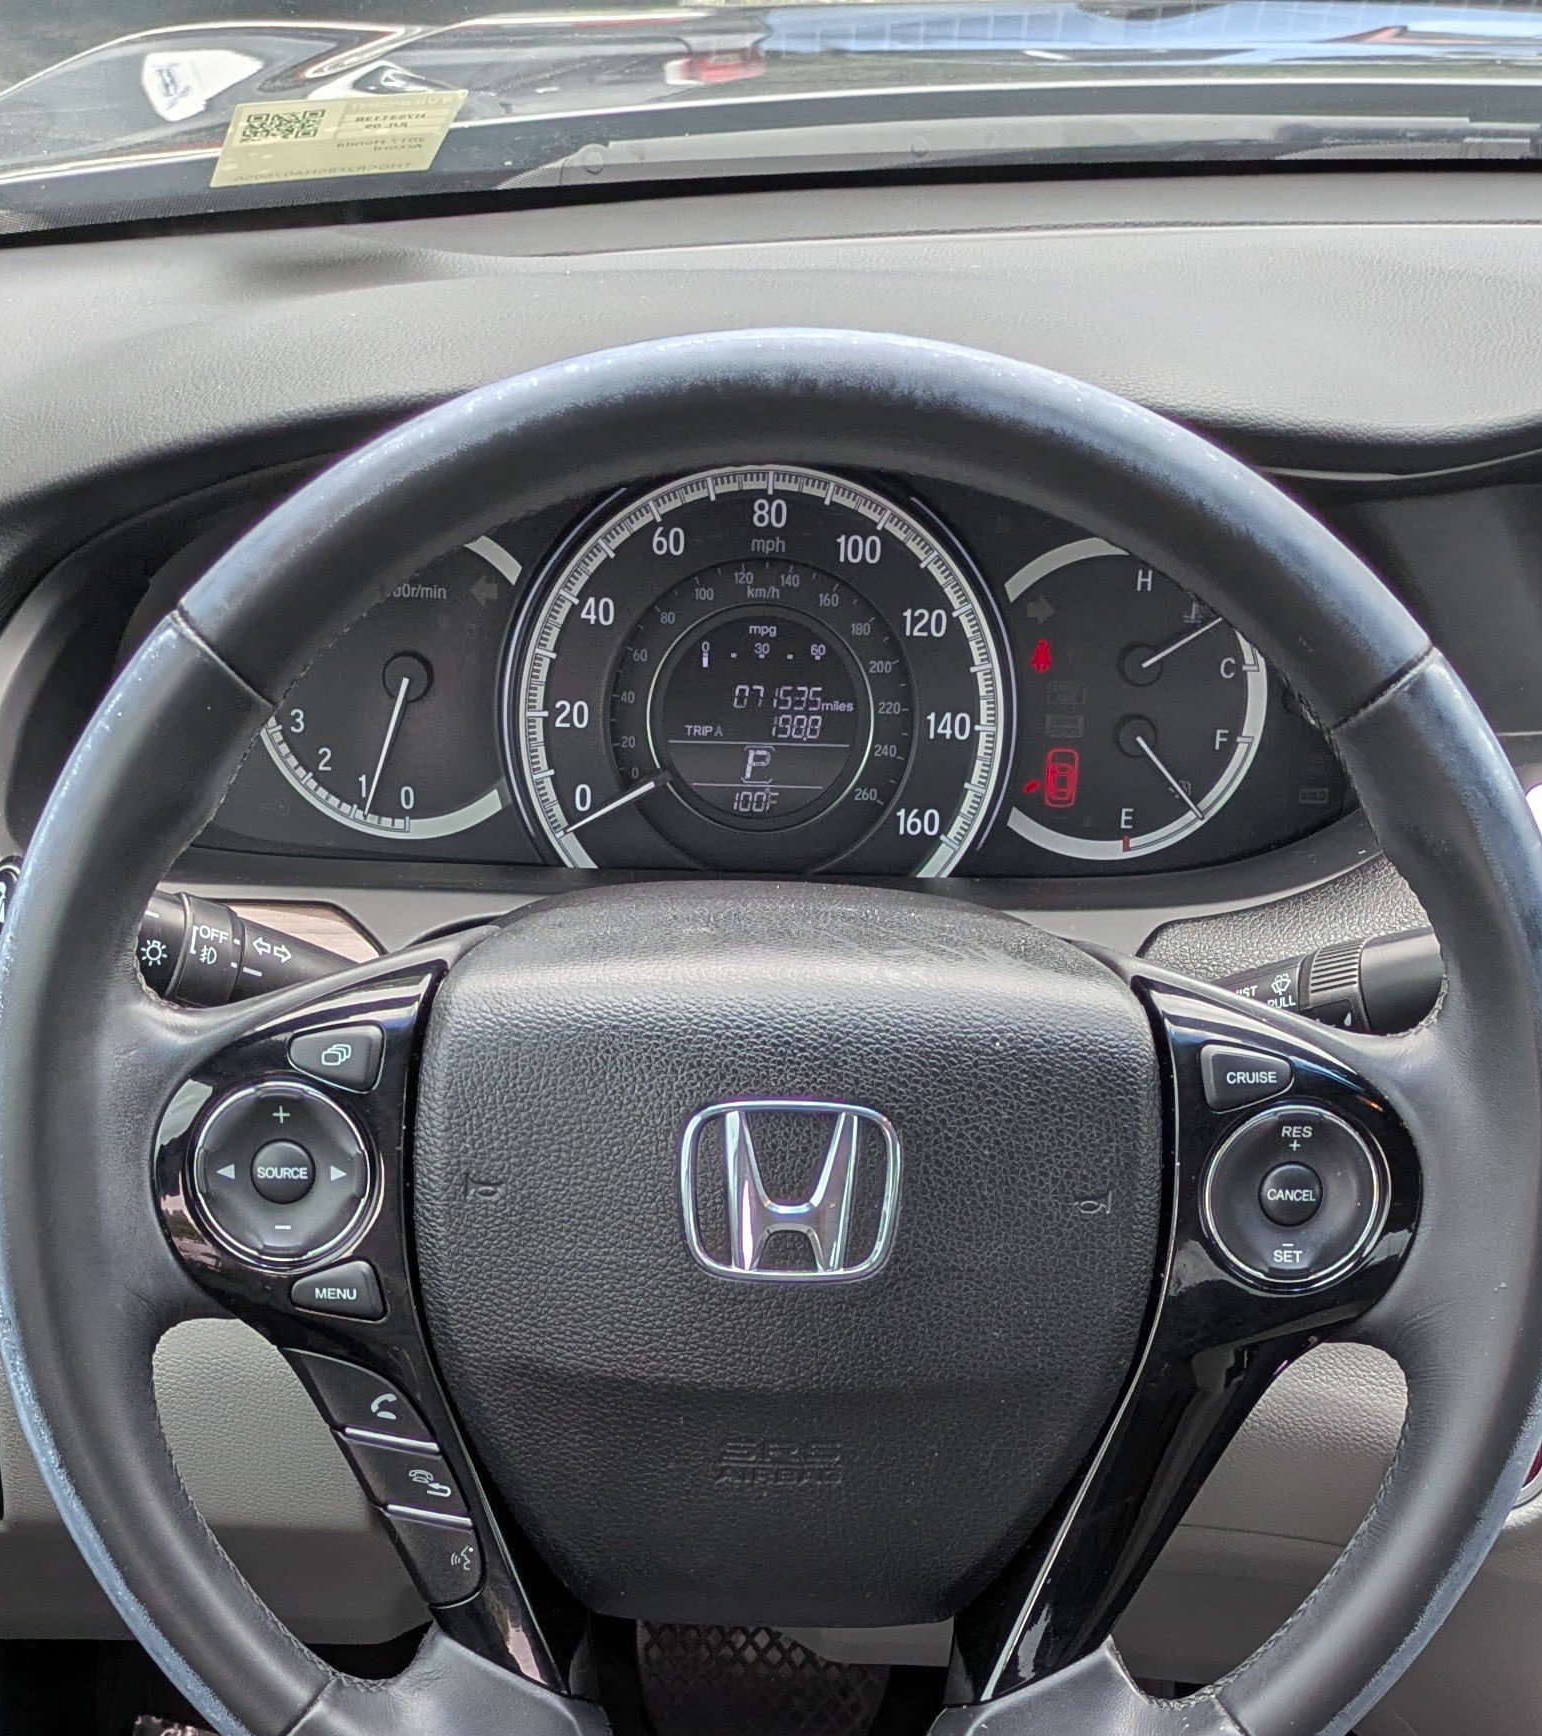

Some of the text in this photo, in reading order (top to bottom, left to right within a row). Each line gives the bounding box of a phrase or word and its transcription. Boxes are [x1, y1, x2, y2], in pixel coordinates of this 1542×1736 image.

[753, 499, 787, 527] 80
[652, 527, 685, 555] 60
[751, 536, 786, 557] mph
[836, 536, 882, 564] 100
[734, 572, 754, 585] 120
[780, 574, 800, 587] 140
[1136, 569, 1153, 592] H
[695, 587, 714, 600] 100
[747, 586, 780, 599] km/h
[819, 594, 839, 607] 160
[580, 597, 615, 625] 40
[660, 612, 676, 624] 80
[851, 623, 871, 635] 180
[903, 609, 947, 637] 120
[748, 624, 777, 637] mpg
[701, 641, 826, 655] 0 30 60
[633, 649, 648, 662] 60
[869, 661, 892, 674] 200
[1220, 657, 1236, 679] C
[620, 691, 635, 704] 40
[821, 701, 854, 712] miles
[878, 702, 901, 715] 220
[290, 710, 305, 732] 3
[554, 700, 589, 729] 20
[685, 725, 713, 736] TRIP
[714, 725, 723, 736] A
[926, 712, 971, 740] 140
[621, 736, 636, 749] 20
[1215, 729, 1229, 750] F
[874, 744, 897, 758] 240
[318, 748, 332, 771] 2
[744, 749, 771, 779] P
[631, 767, 639, 780] 0
[358, 775, 367, 798] 1
[400, 787, 415, 810] 0
[575, 783, 592, 811] 0
[854, 788, 878, 801] 260
[896, 809, 940, 836] 160
[1120, 808, 1134, 829] E
[198, 924, 230, 943] OFF
[1226, 1071, 1277, 1085] CRUISE
[1281, 1125, 1312, 1139] RES
[257, 1166, 308, 1180] SOURCE
[1266, 1188, 1317, 1202] CANCEL
[1273, 1249, 1303, 1263] SET
[314, 1287, 357, 1301] MENU
